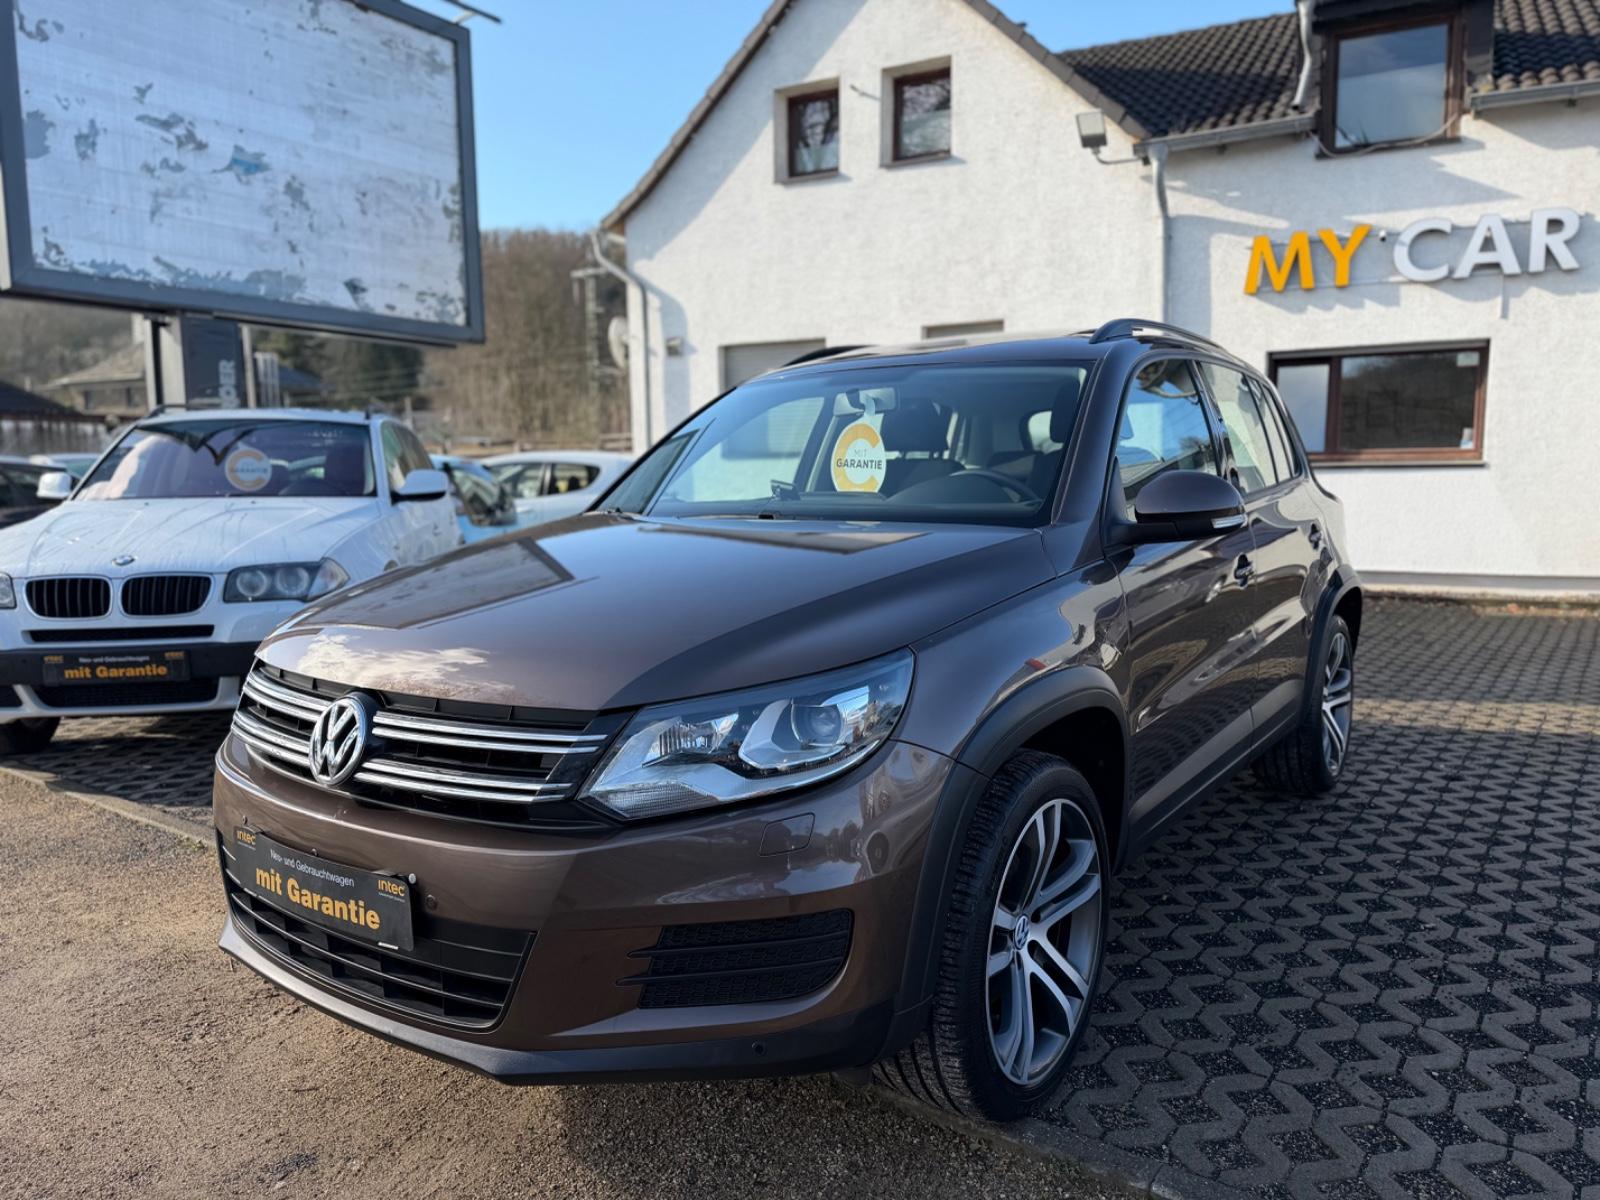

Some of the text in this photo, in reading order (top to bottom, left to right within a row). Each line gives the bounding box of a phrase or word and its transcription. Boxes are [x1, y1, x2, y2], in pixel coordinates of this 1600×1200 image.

[1244, 207, 1581, 296] MY CAR
[836, 458, 883, 470] GARANTIE
[64, 664, 168, 679] mit Garantie
[284, 857, 295, 868] und
[295, 860, 354, 887] Gebrauchtwagen
[255, 867, 381, 930] mit Garantie
